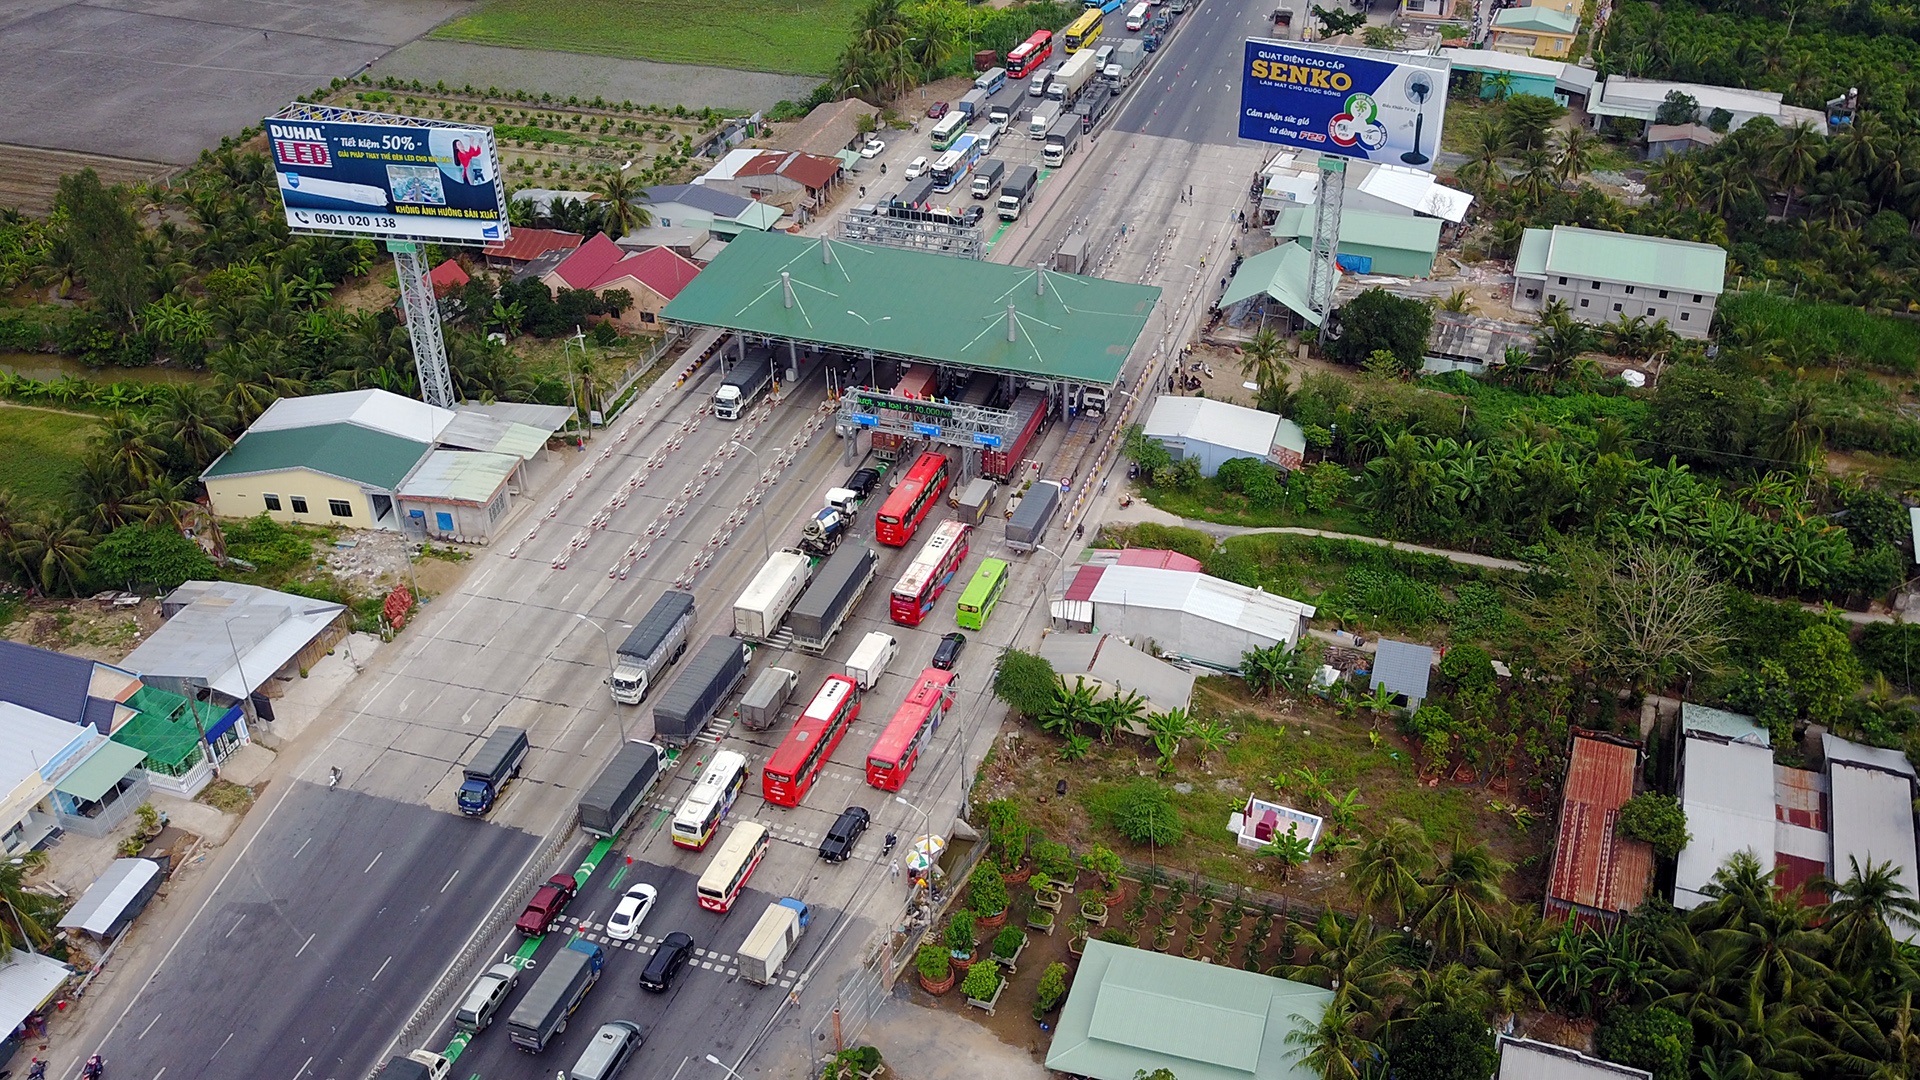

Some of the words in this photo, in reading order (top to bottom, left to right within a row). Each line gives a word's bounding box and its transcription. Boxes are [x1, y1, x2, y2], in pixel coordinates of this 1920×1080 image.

[1283, 54, 1304, 64] ĐIỆN
[1306, 58, 1325, 67] CAO
[1326, 60, 1345, 70] CẤP
[1251, 59, 1352, 91] SENKO
[1264, 112, 1283, 122] nhận
[1297, 118, 1310, 126] gió
[270, 125, 327, 141] DUHAL
[358, 138, 380, 150] kiệm
[277, 142, 328, 165] LED
[395, 204, 420, 214] KHÔNG
[314, 213, 344, 225] 0901
[348, 216, 370, 227] 020
[374, 218, 396, 228] 138
[503, 952, 537, 970] VETC
